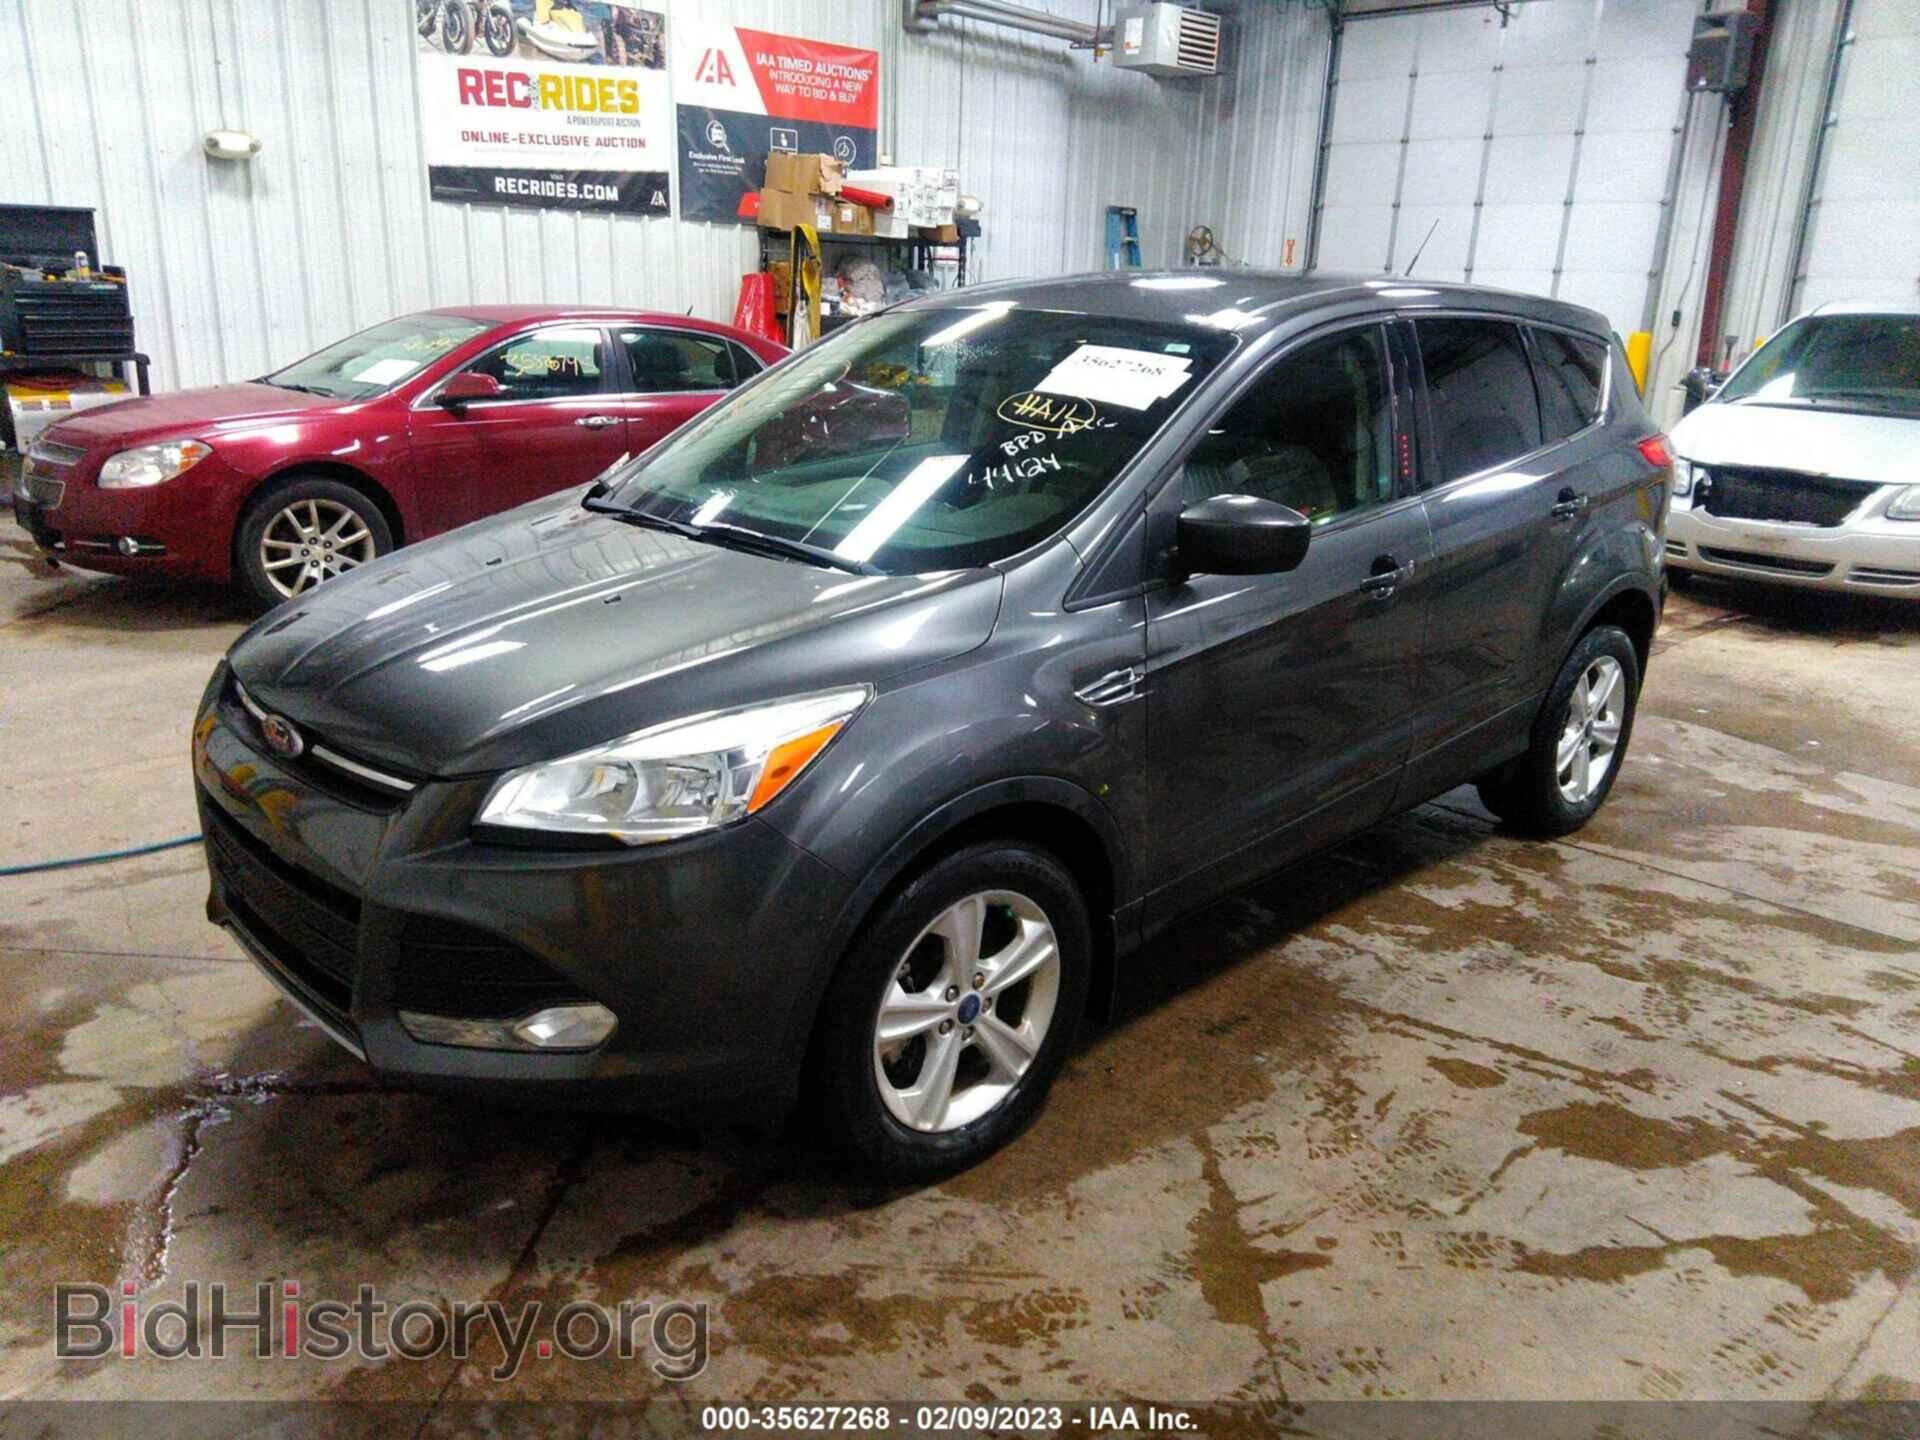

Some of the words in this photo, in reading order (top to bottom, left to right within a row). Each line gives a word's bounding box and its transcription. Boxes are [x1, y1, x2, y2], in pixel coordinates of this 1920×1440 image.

[756, 52, 775, 66] IAA
[776, 56, 813, 73] TIMED
[457, 68, 532, 109] REC
[538, 73, 640, 114] RIDES
[769, 70, 832, 88] INTRODUCING
[832, 79, 841, 88] A
[842, 80, 863, 92] NEW
[775, 82, 797, 94] WAY
[799, 86, 812, 97] TO
[838, 91, 857, 103] BUY
[461, 131, 591, 147] ONLINE-EXCLUSIVE
[595, 136, 646, 149] AUCTION
[494, 177, 619, 201] RECRIDES.COM
